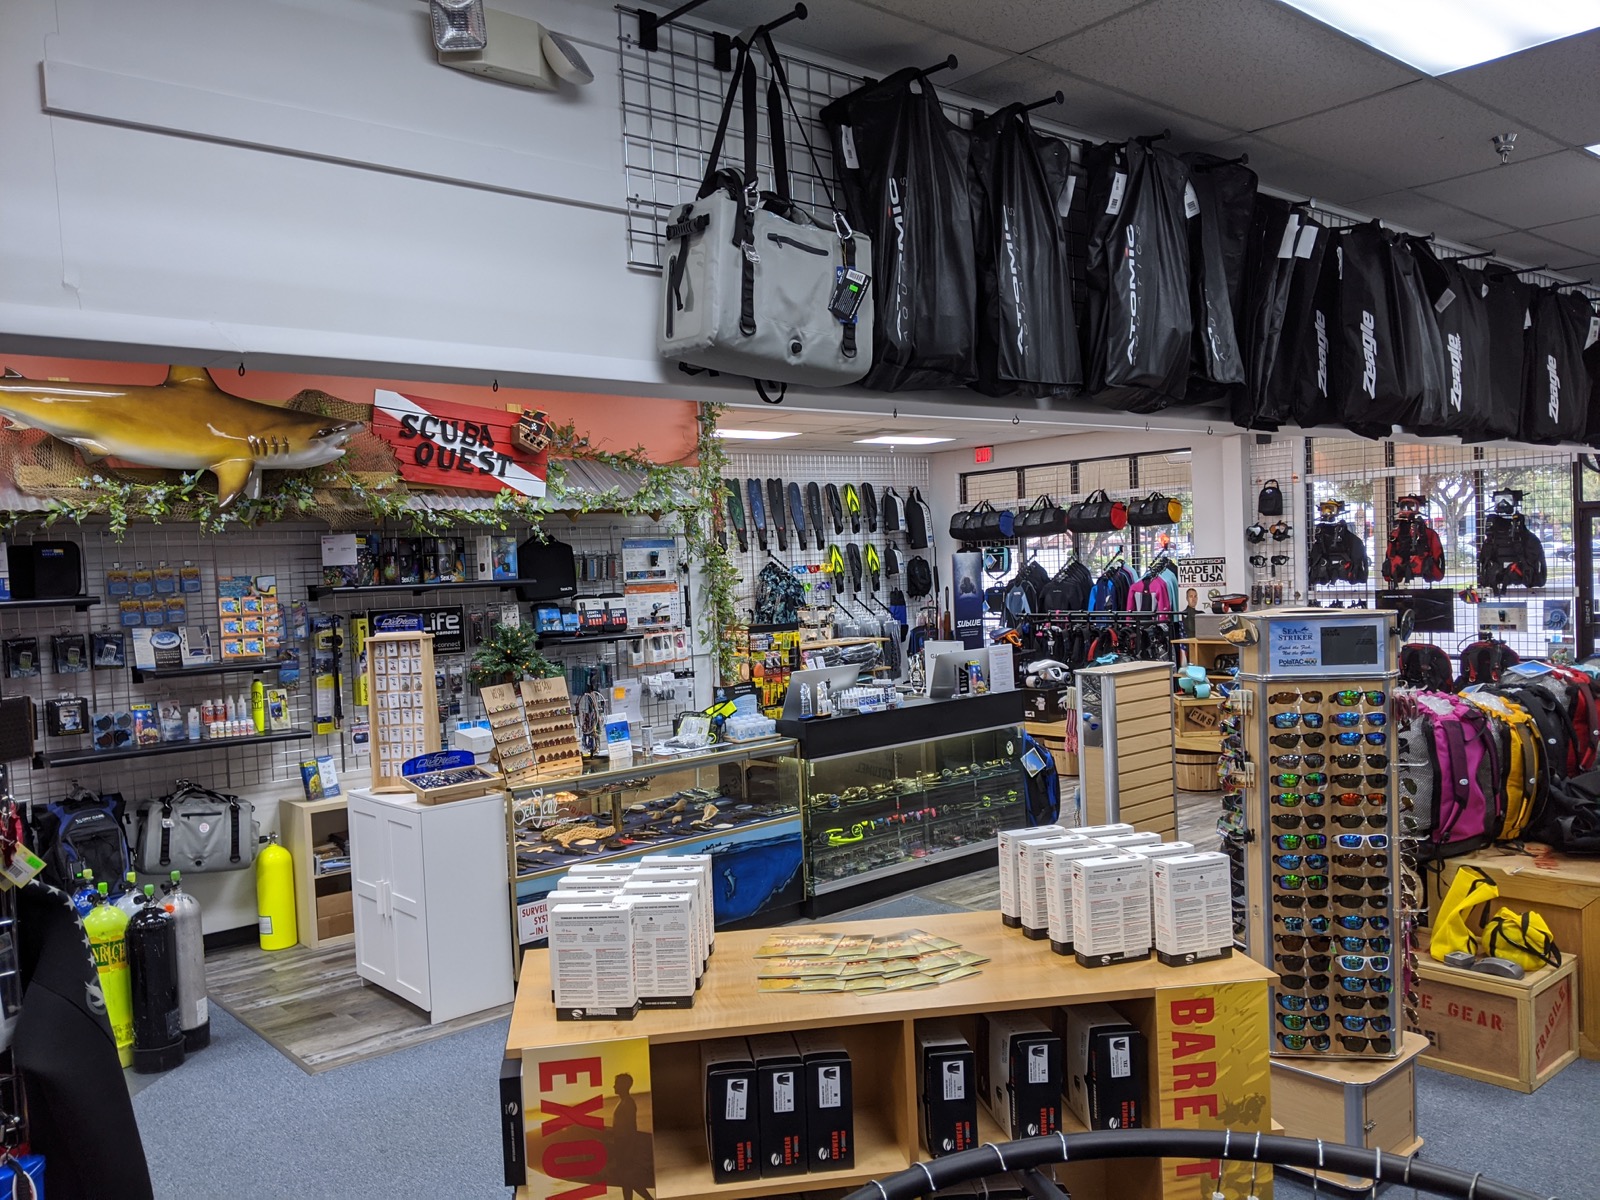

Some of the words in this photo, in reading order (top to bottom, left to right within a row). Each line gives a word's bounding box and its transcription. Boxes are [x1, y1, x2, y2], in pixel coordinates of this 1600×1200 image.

[1126, 224, 1137, 367] ATOMIC
[1314, 310, 1329, 399] Zeagle
[1360, 310, 1377, 400] Zeagle
[1547, 354, 1561, 424] Zeagle
[400, 414, 495, 448] SCUBA
[415, 441, 514, 477] QUEST
[1179, 565, 1209, 574] MADE
[1212, 565, 1223, 574] IN
[1179, 574, 1197, 583] THE
[1200, 573, 1224, 582] USA
[1190, 710, 1214, 727] FINS
[1448, 1002, 1504, 1032] GEAR
[1535, 986, 1567, 1061] FRAGILE
[1170, 997, 1218, 1121] BARE
[539, 1056, 608, 1200] EXO
